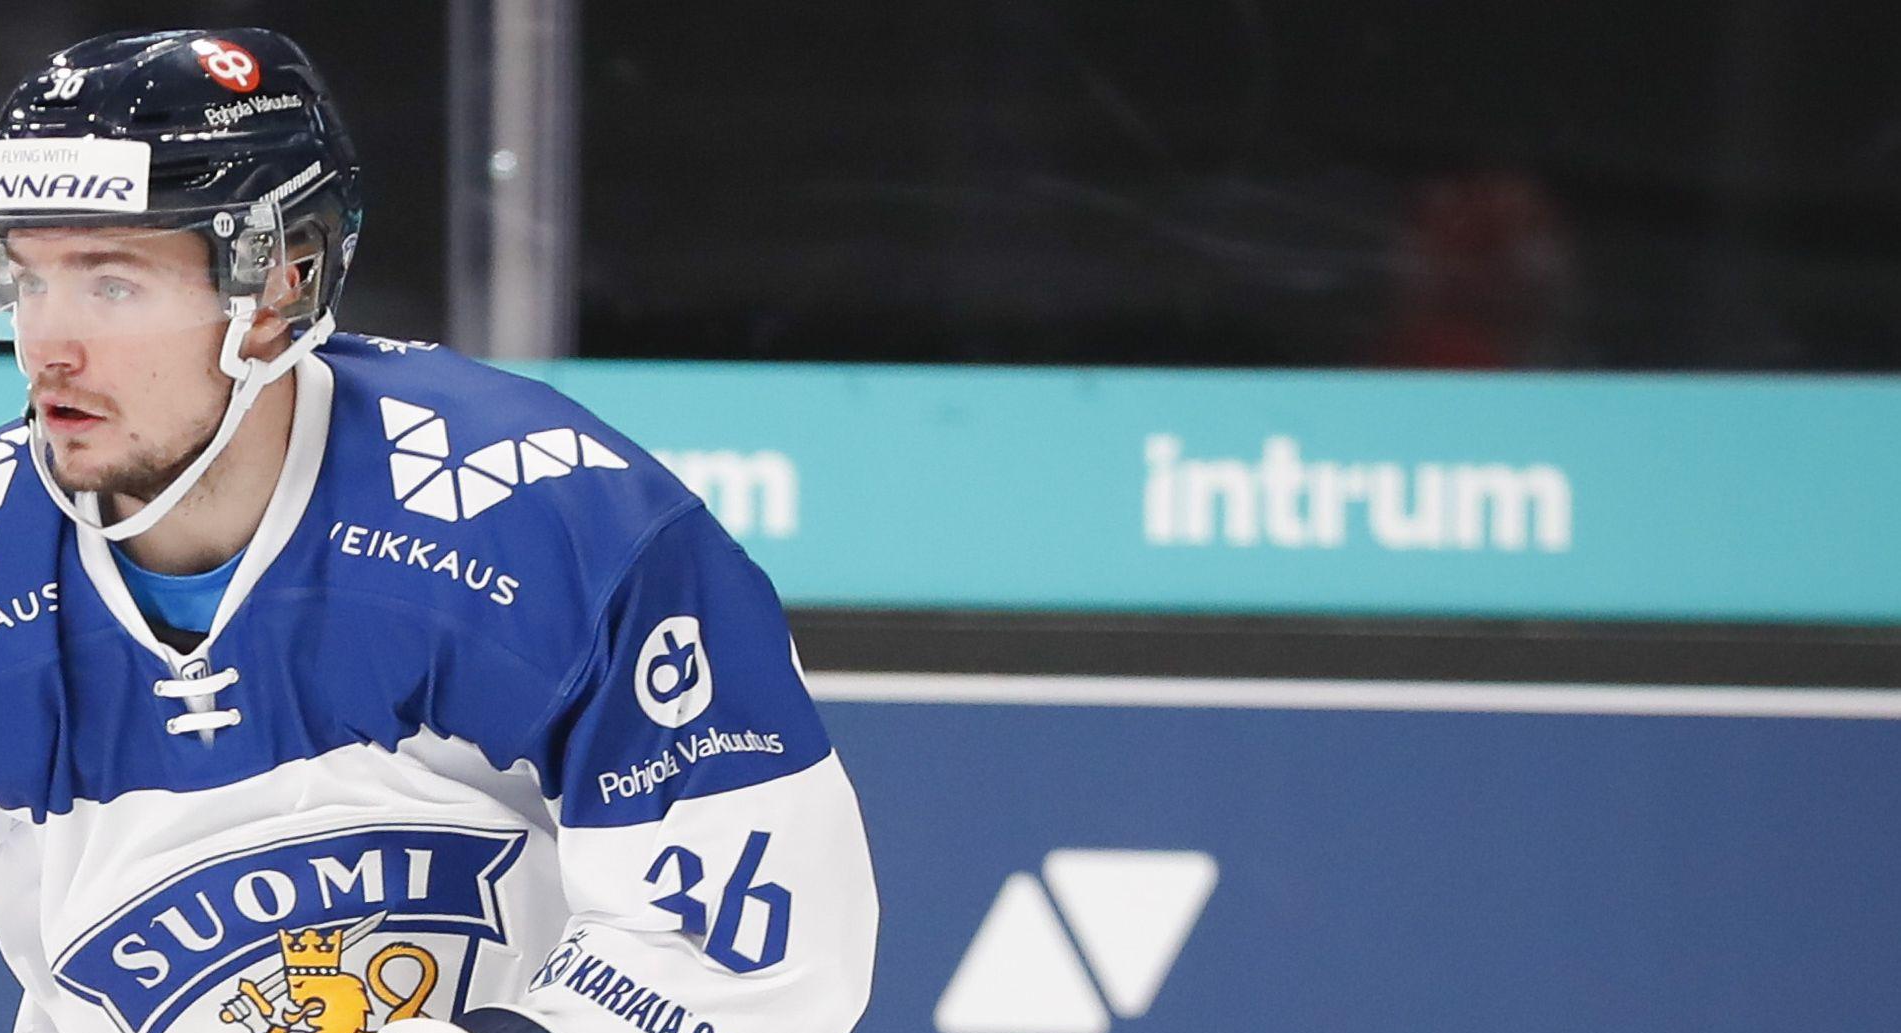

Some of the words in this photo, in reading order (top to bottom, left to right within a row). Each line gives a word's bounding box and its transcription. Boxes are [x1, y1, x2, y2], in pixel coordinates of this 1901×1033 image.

[1, 149, 41, 164] FLYING
[43, 148, 79, 163] WITH
[1143, 434, 1572, 551] intrum
[598, 748, 678, 804] Pohjola
[675, 727, 784, 767] Vakuutus
[111, 847, 435, 990] SUOMI
[643, 831, 792, 975] 36
